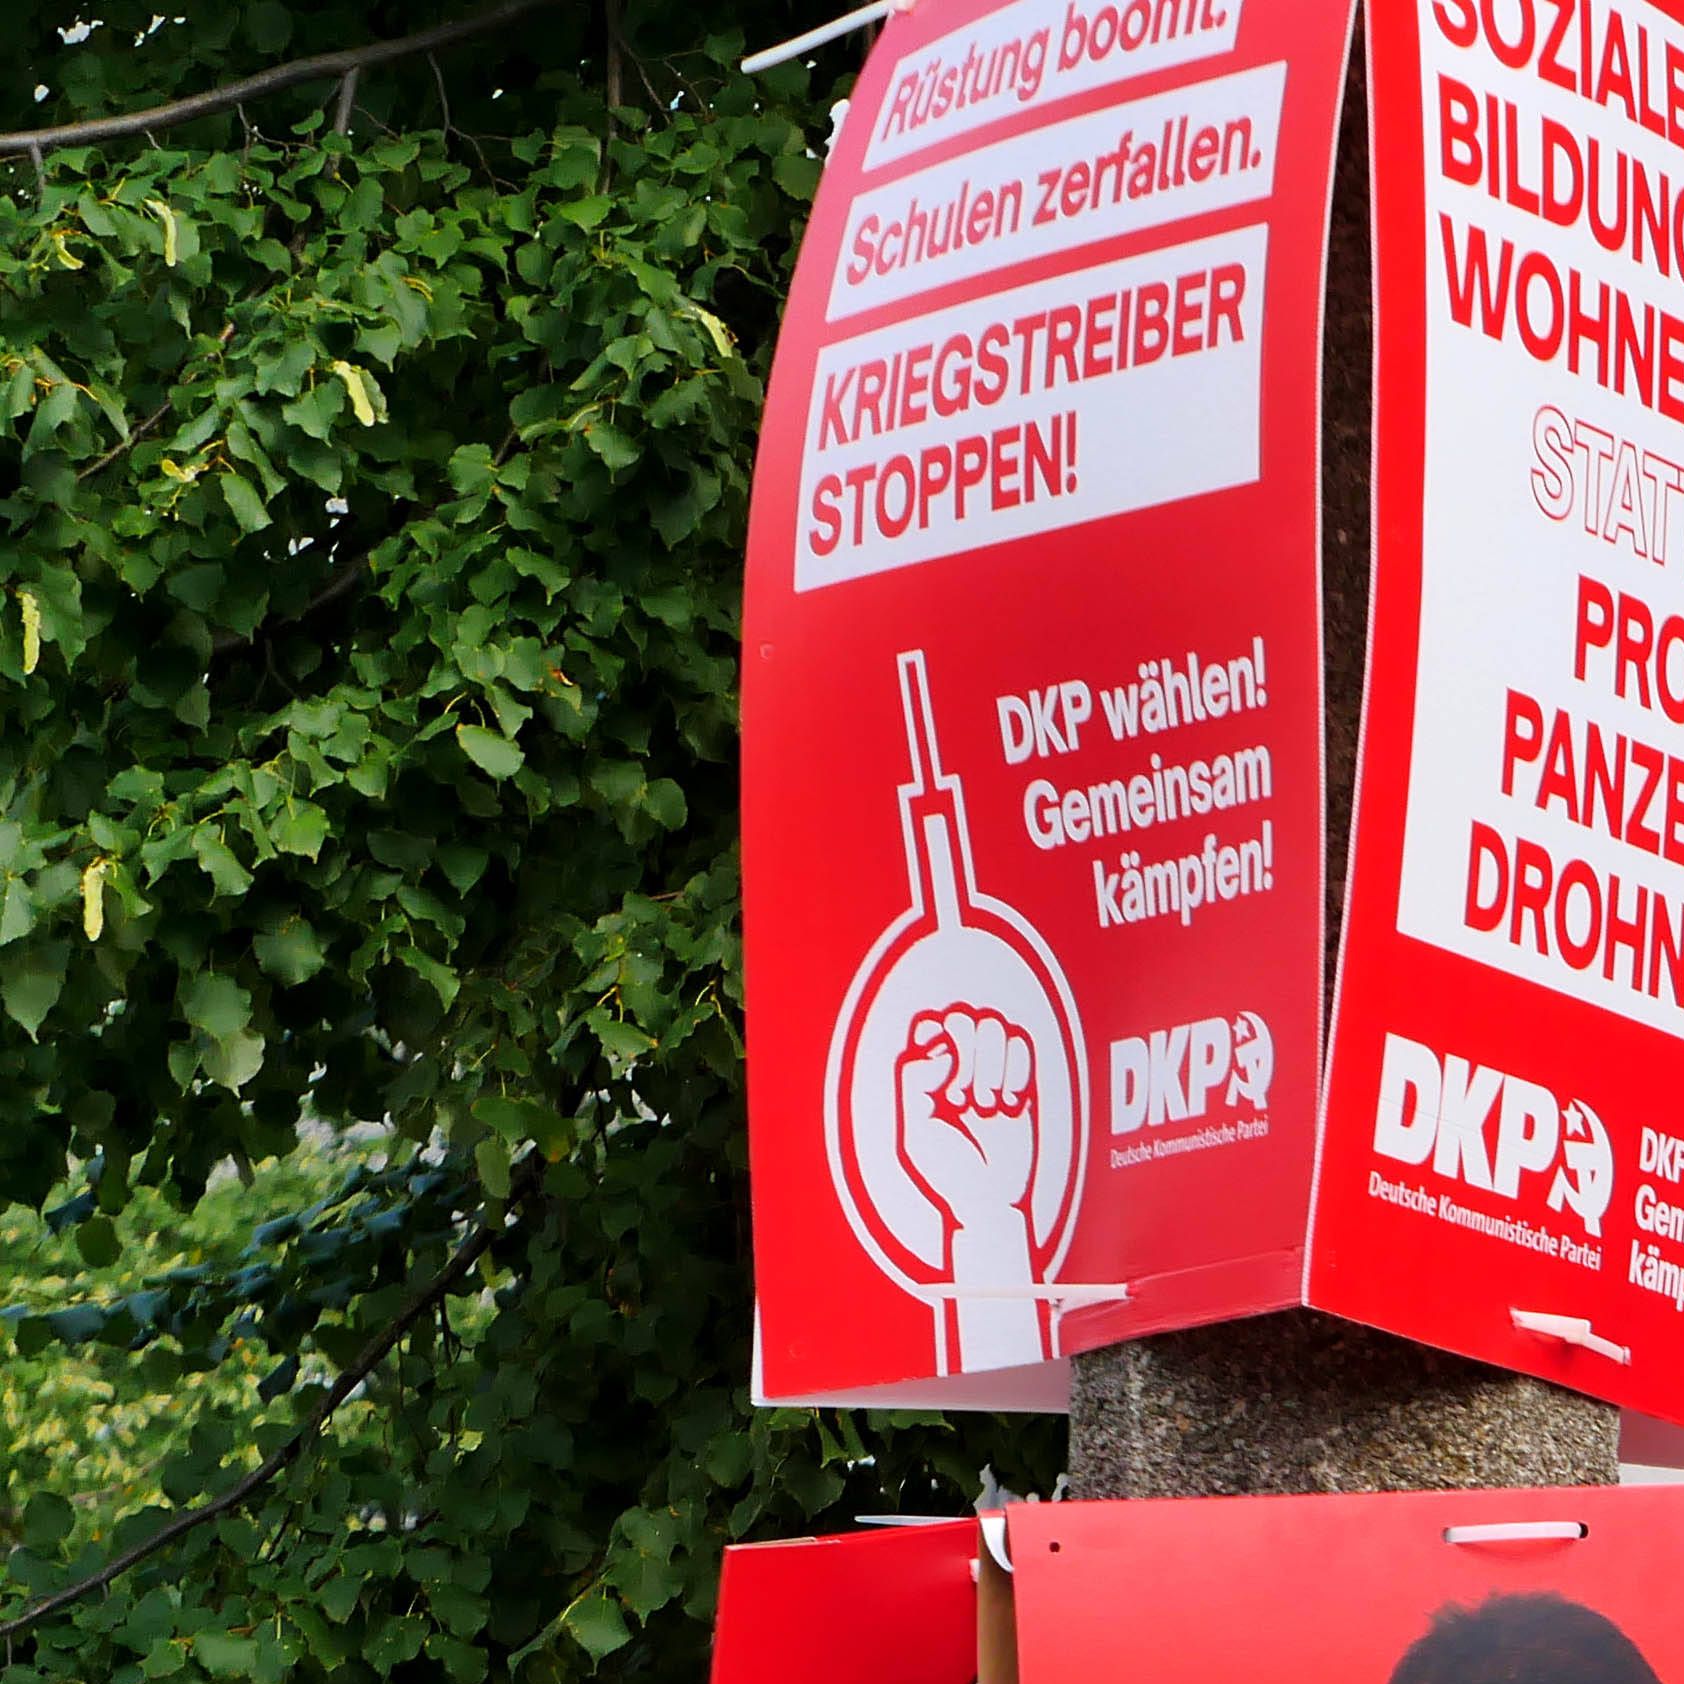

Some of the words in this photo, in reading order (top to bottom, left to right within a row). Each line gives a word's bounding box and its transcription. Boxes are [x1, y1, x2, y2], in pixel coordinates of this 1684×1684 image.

[882, 26, 1050, 142] Rüstung
[846, 186, 1022, 287] Schulen
[1032, 114, 1263, 226] zerfallen.
[818, 262, 1247, 451] KRIEGSTREIBER
[808, 410, 1078, 557] STOPPEN!
[996, 679, 1093, 765] DKP
[1100, 636, 1268, 741] wählen!
[1023, 744, 1273, 850] Gemeinsam
[1092, 820, 1274, 928] kämpfen!
[1110, 1017, 1231, 1135] DKP
[1372, 1032, 1560, 1200] DKP
[1110, 1141, 1152, 1169] Deutsche
[1236, 1114, 1269, 1140] Partei
[1368, 1171, 1437, 1217] Deutsche
[1438, 1194, 1559, 1256] Kommunistische
[1560, 1235, 1602, 1271] Partei
